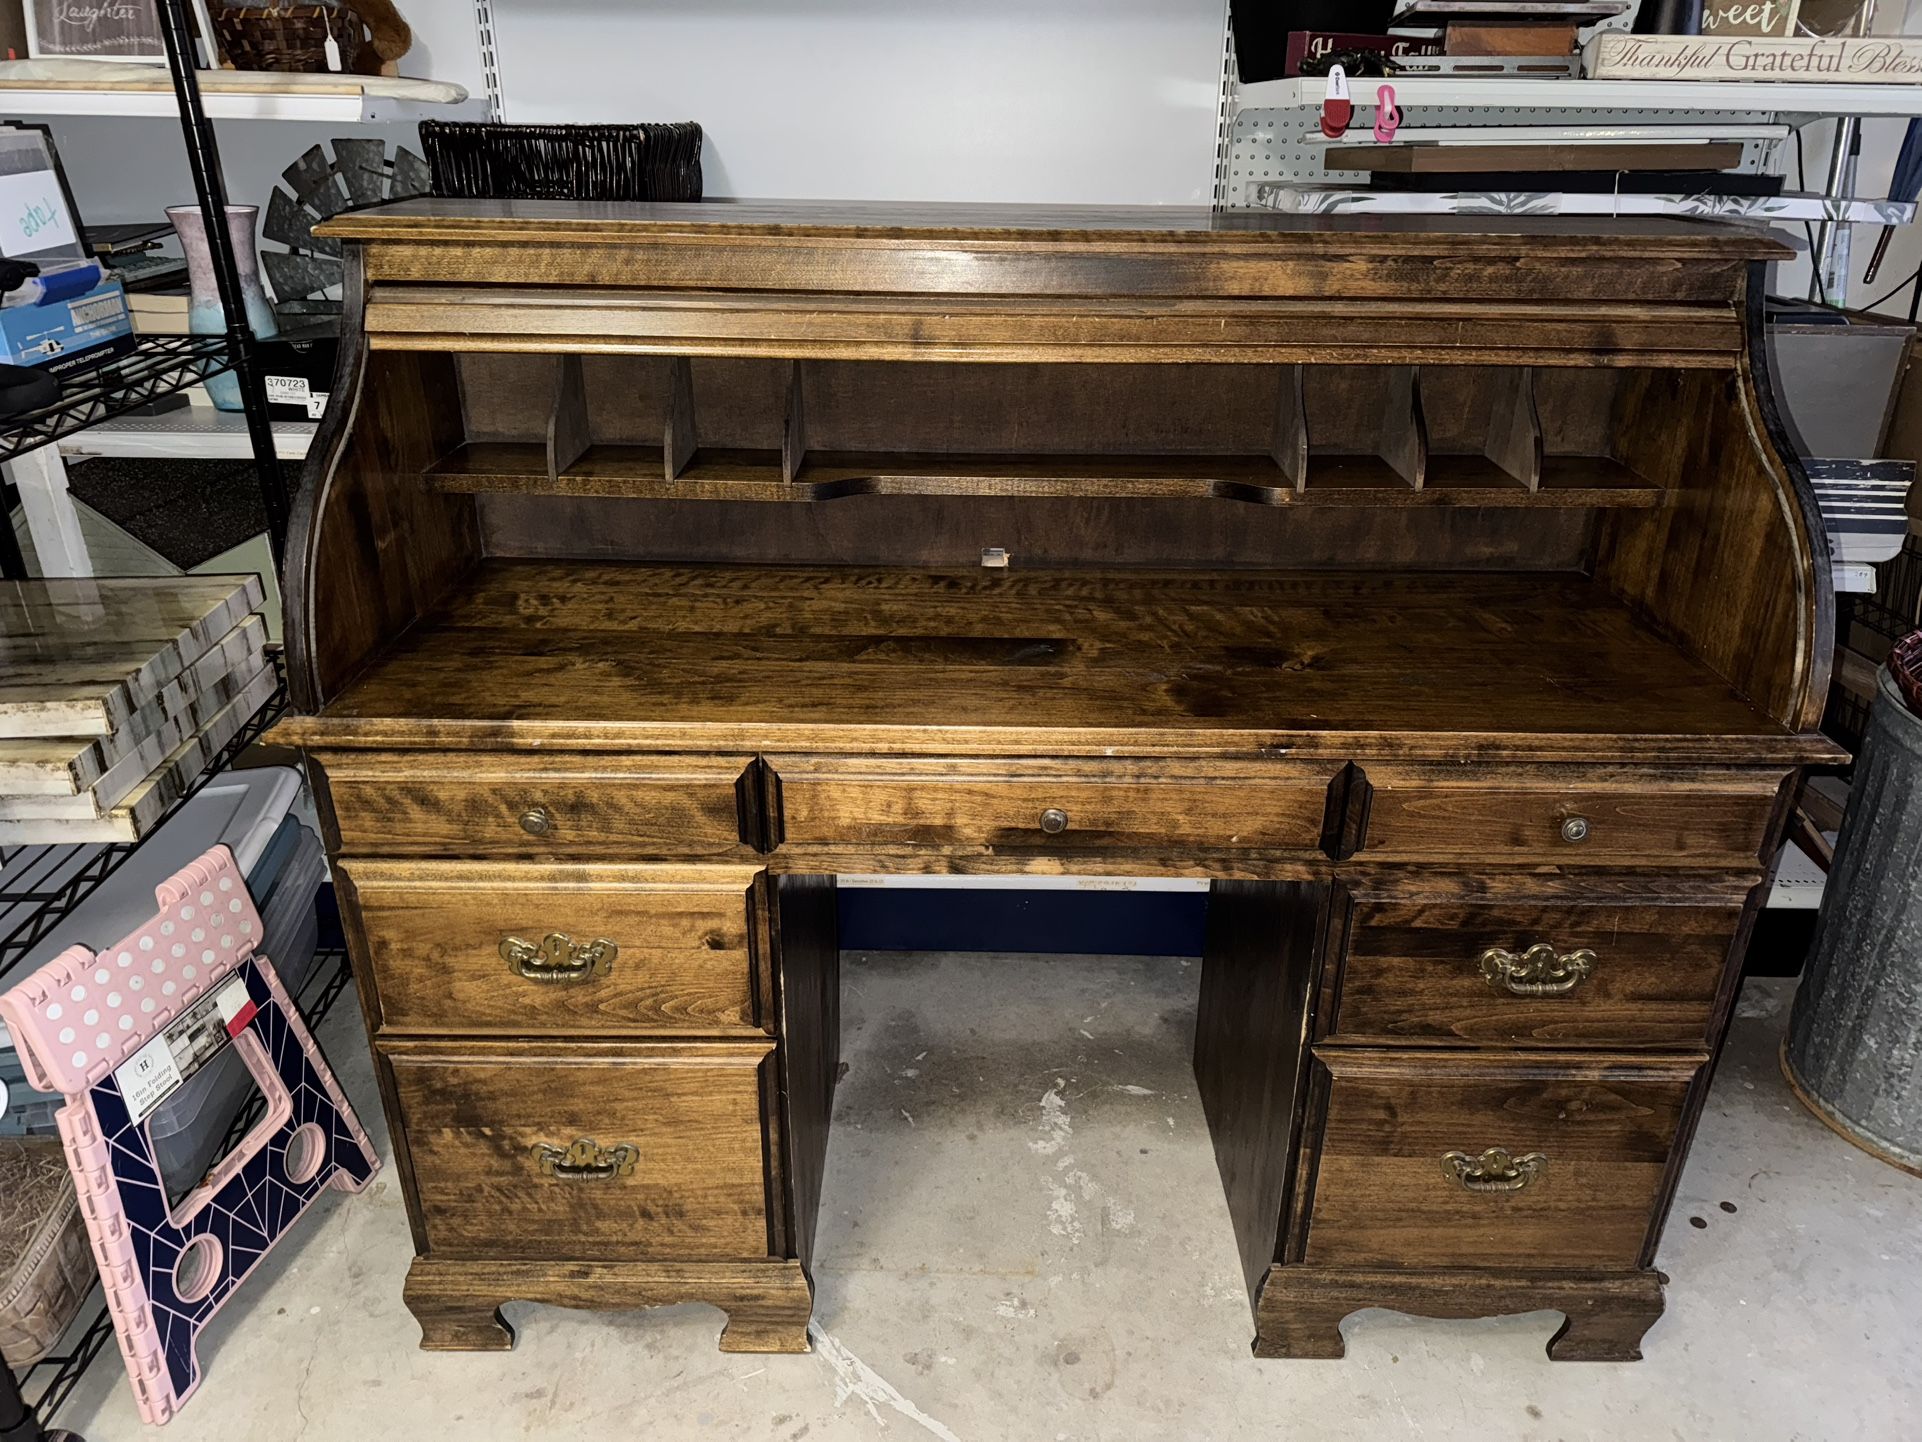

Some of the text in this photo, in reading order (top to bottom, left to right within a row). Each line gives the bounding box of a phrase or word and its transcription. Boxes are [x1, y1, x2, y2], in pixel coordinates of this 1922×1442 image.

[54, 0, 142, 32] Laughter
[1702, 1, 1780, 33] weet
[1609, 38, 1922, 78] Thankful Grateful Bless
[267, 378, 306, 388] 370723
[140, 1060, 149, 1072] H
[147, 1065, 172, 1087] Folding
[140, 1090, 155, 1106] Step
[155, 1073, 173, 1091] Stool
